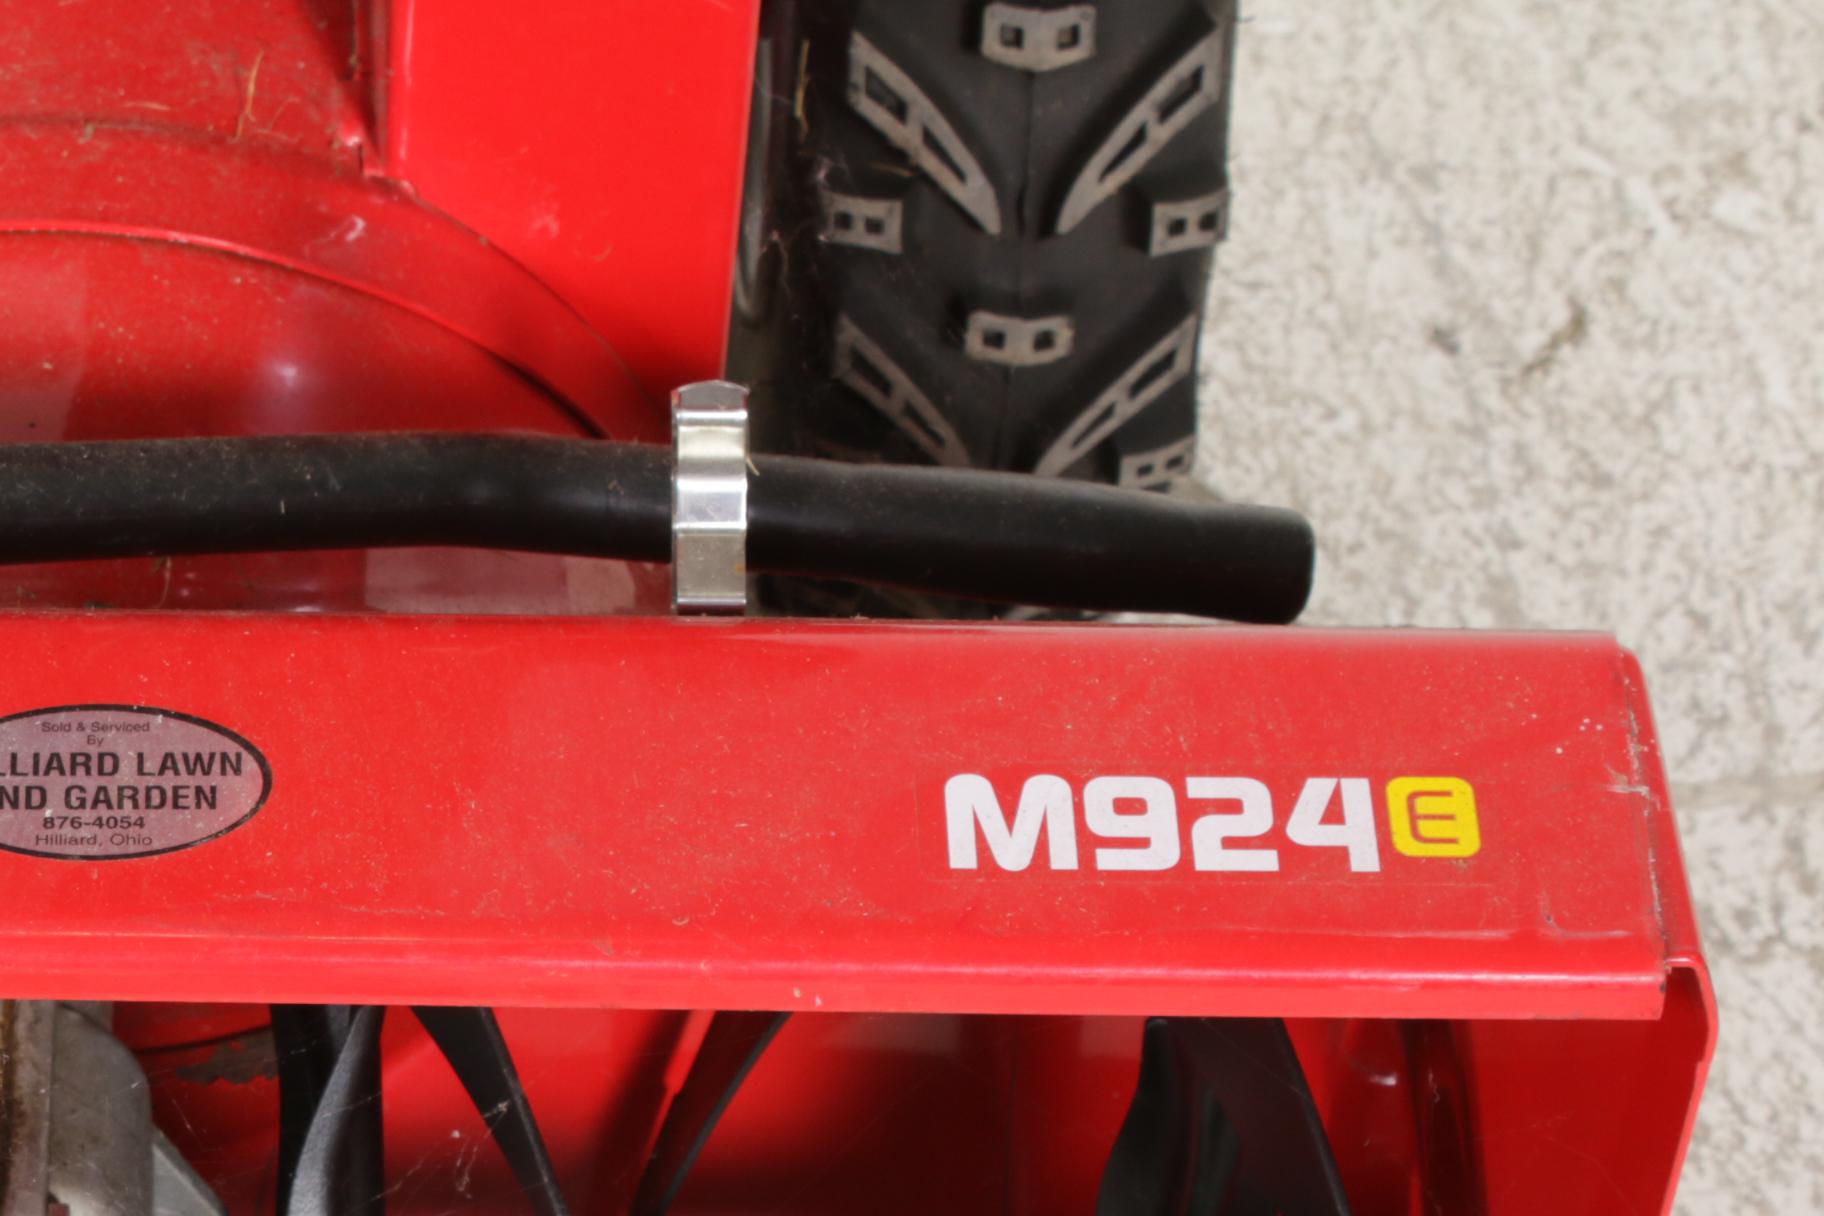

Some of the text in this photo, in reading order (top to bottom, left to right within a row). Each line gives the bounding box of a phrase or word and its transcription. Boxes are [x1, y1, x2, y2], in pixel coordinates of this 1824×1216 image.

[41, 720, 151, 733] Sold & Serviced
[86, 734, 104, 747] By
[136, 751, 243, 777] LAWN
[63, 784, 218, 811] GARDEN
[42, 815, 146, 830] 876-4054
[35, 833, 154, 848] Hilliard, Ohio
